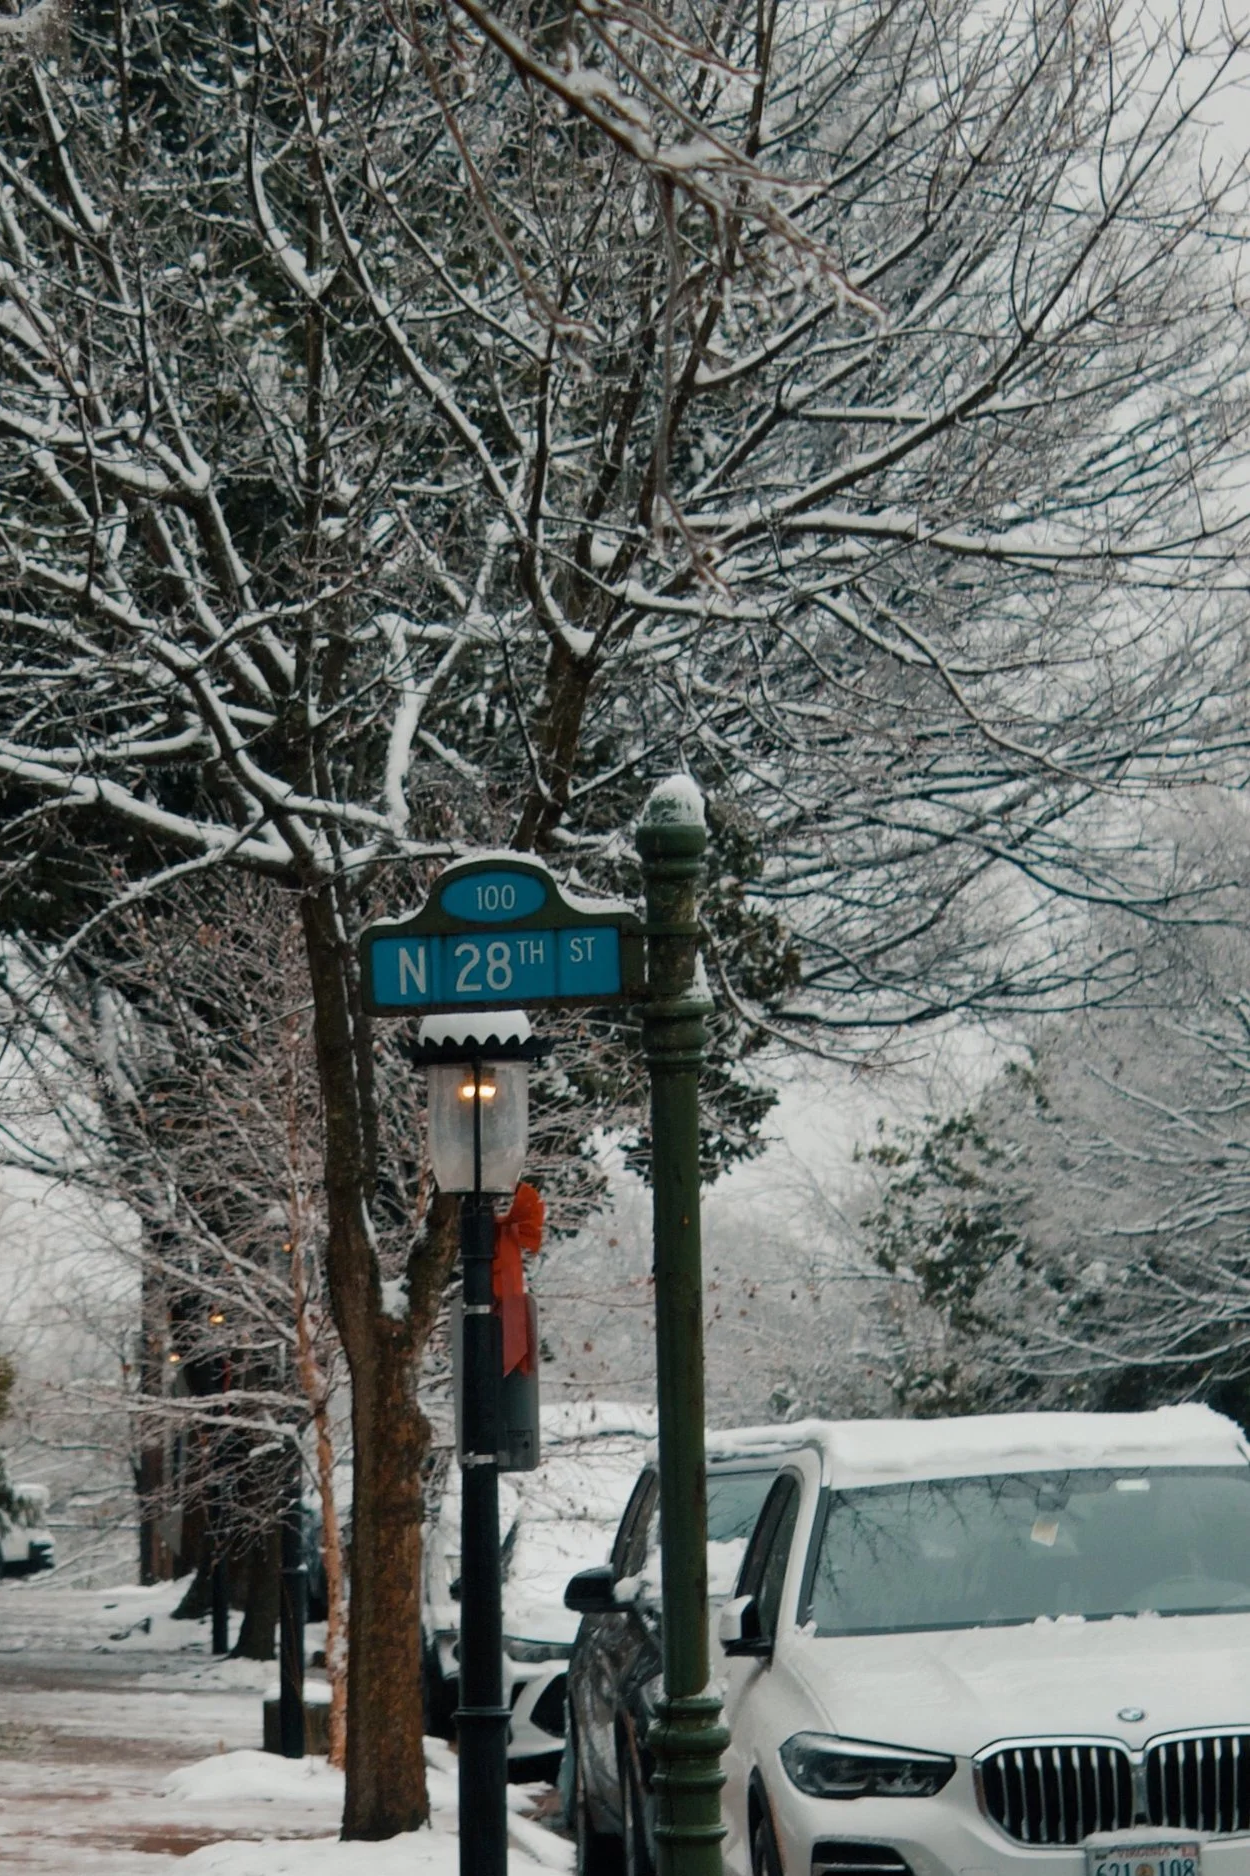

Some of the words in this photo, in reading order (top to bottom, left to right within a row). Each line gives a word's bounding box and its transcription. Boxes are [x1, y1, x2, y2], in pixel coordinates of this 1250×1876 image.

[475, 884, 516, 911] 100
[398, 946, 427, 996] N
[453, 939, 545, 993] 28TH
[569, 936, 596, 962] ST
